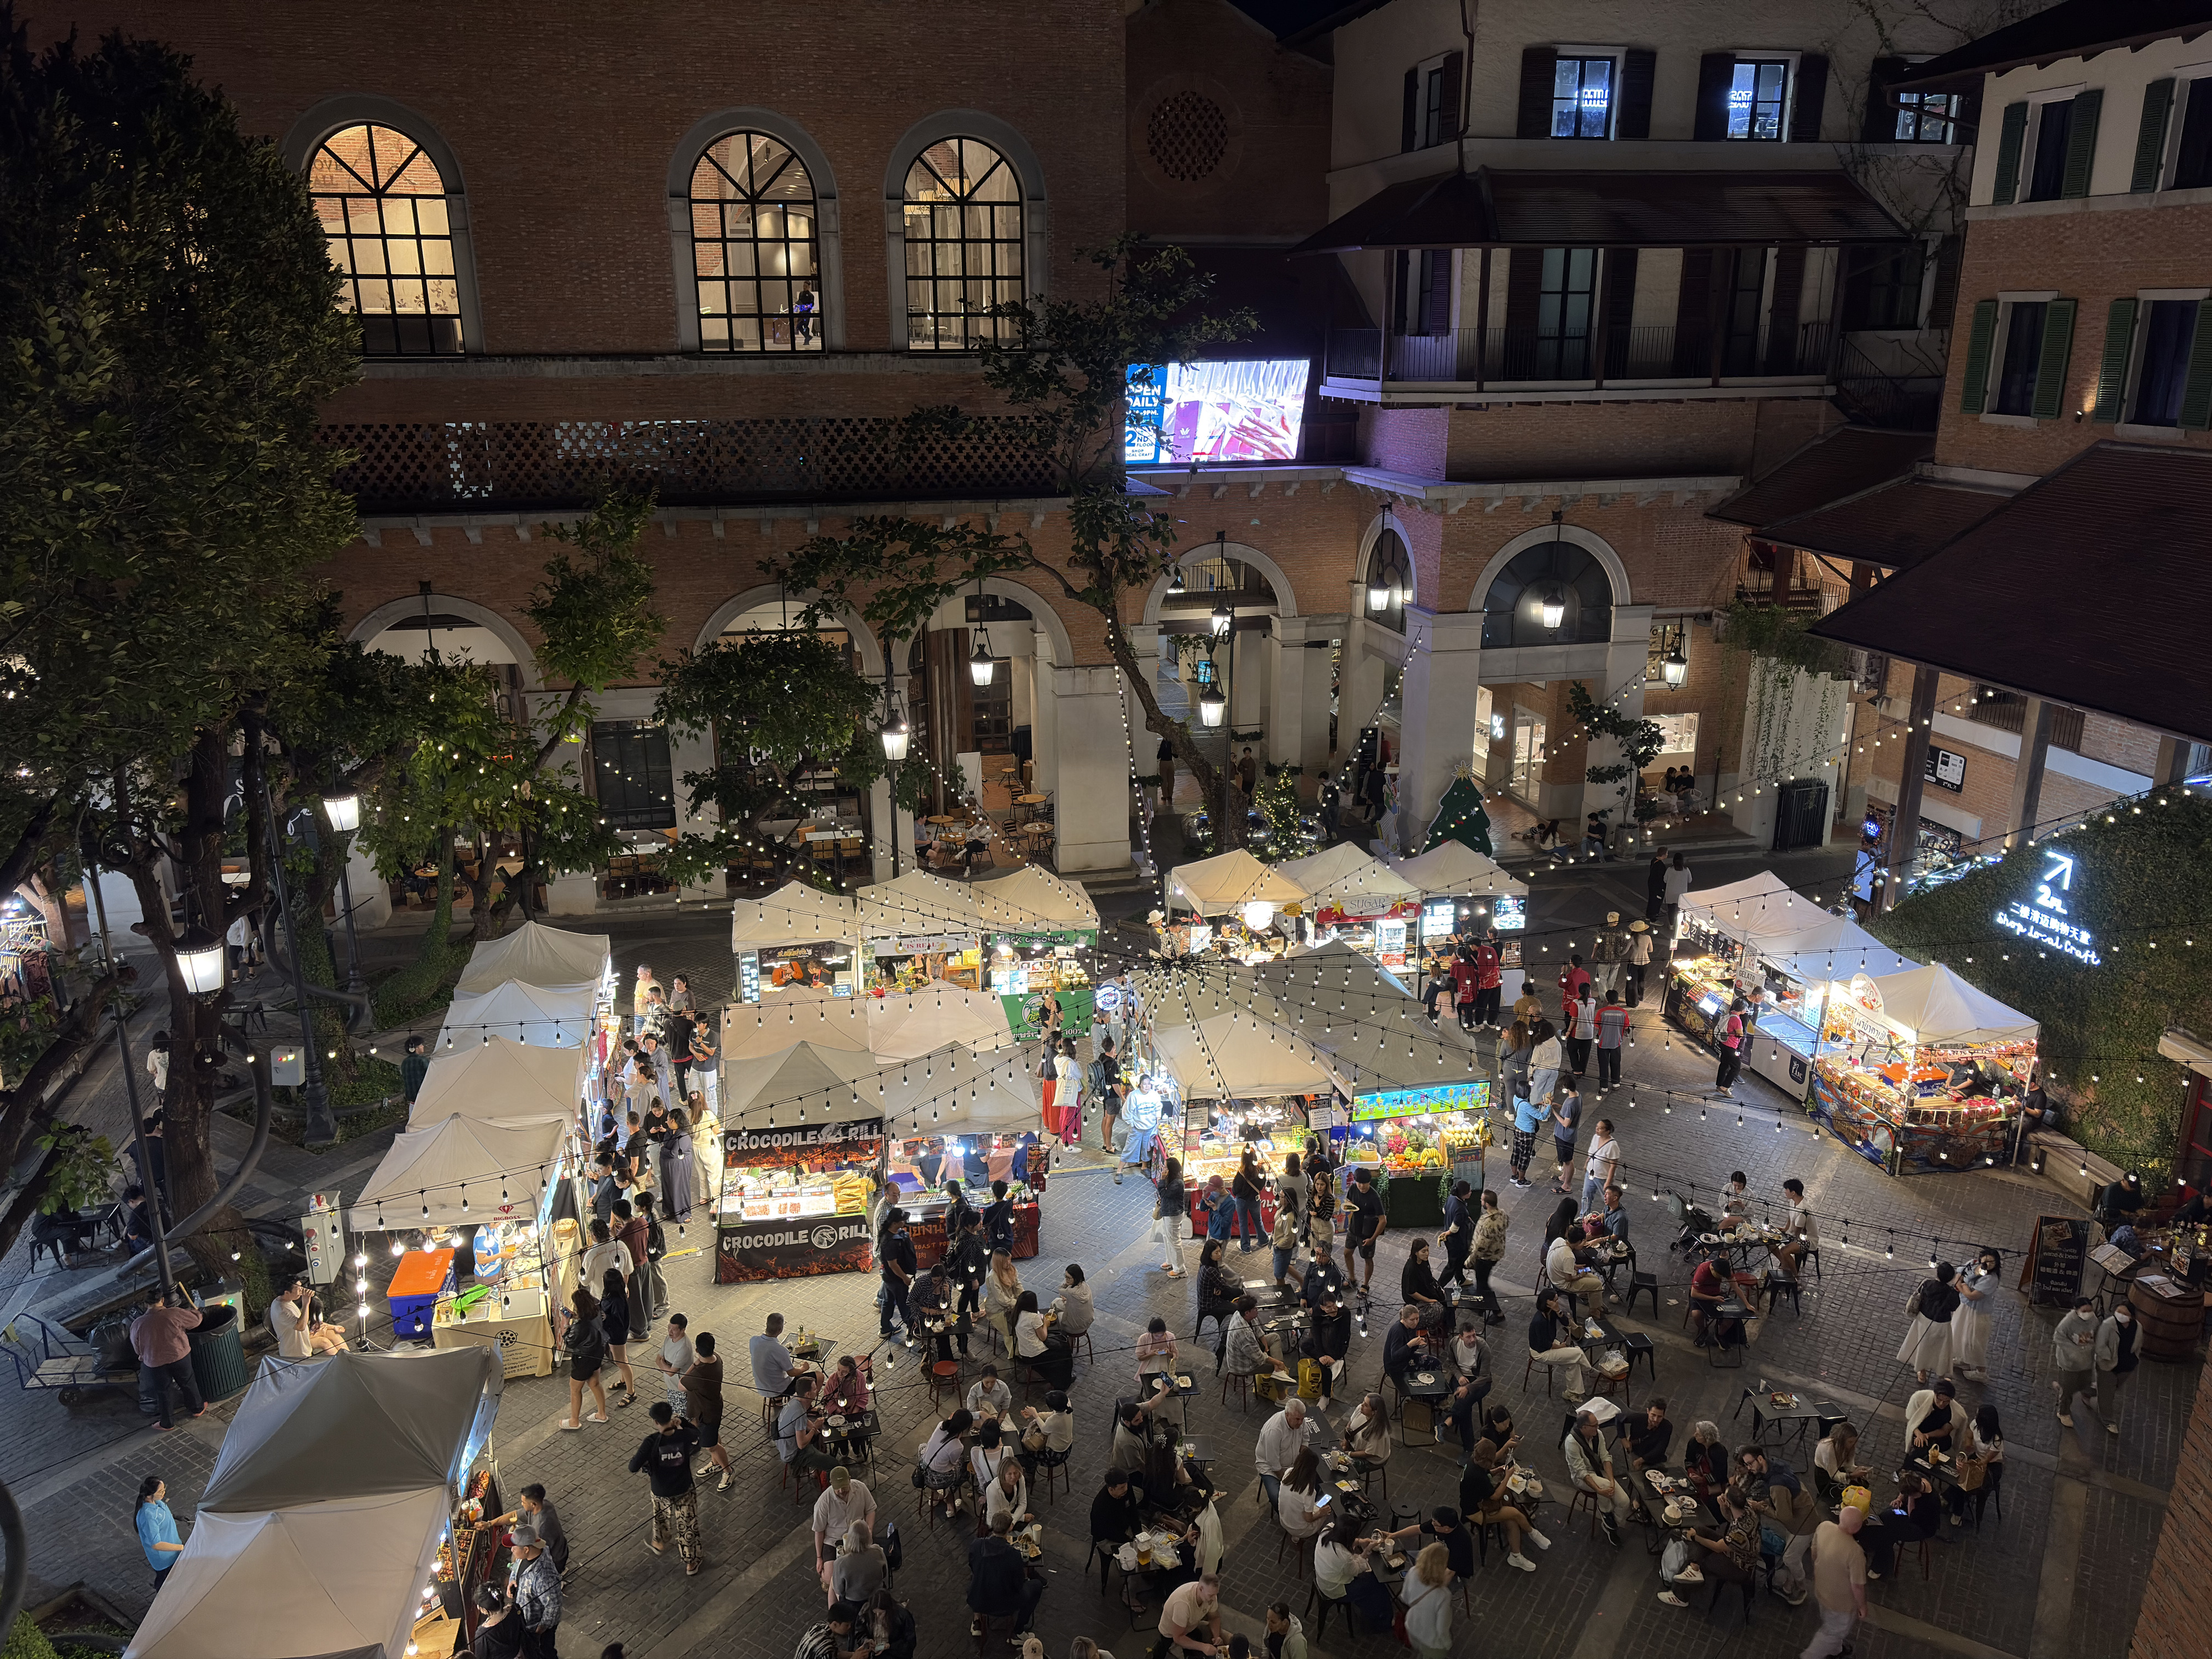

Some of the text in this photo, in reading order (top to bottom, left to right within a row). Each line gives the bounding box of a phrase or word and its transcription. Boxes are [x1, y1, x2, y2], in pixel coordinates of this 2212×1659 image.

[1125, 431, 1137, 447] 2
[1492, 715, 1504, 739] %
[1350, 898, 1386, 909] SUGAR
[997, 935, 1022, 943] Jack
[1996, 912, 2027, 936] Shop
[2064, 940, 2101, 966] Craft
[1739, 970, 1755, 982] GELATO
[1745, 980, 1754, 988] LOW
[726, 1131, 818, 1151] CROCODILE
[722, 1229, 809, 1251] CROCODILE
[661, 1451, 683, 1461] FILA
